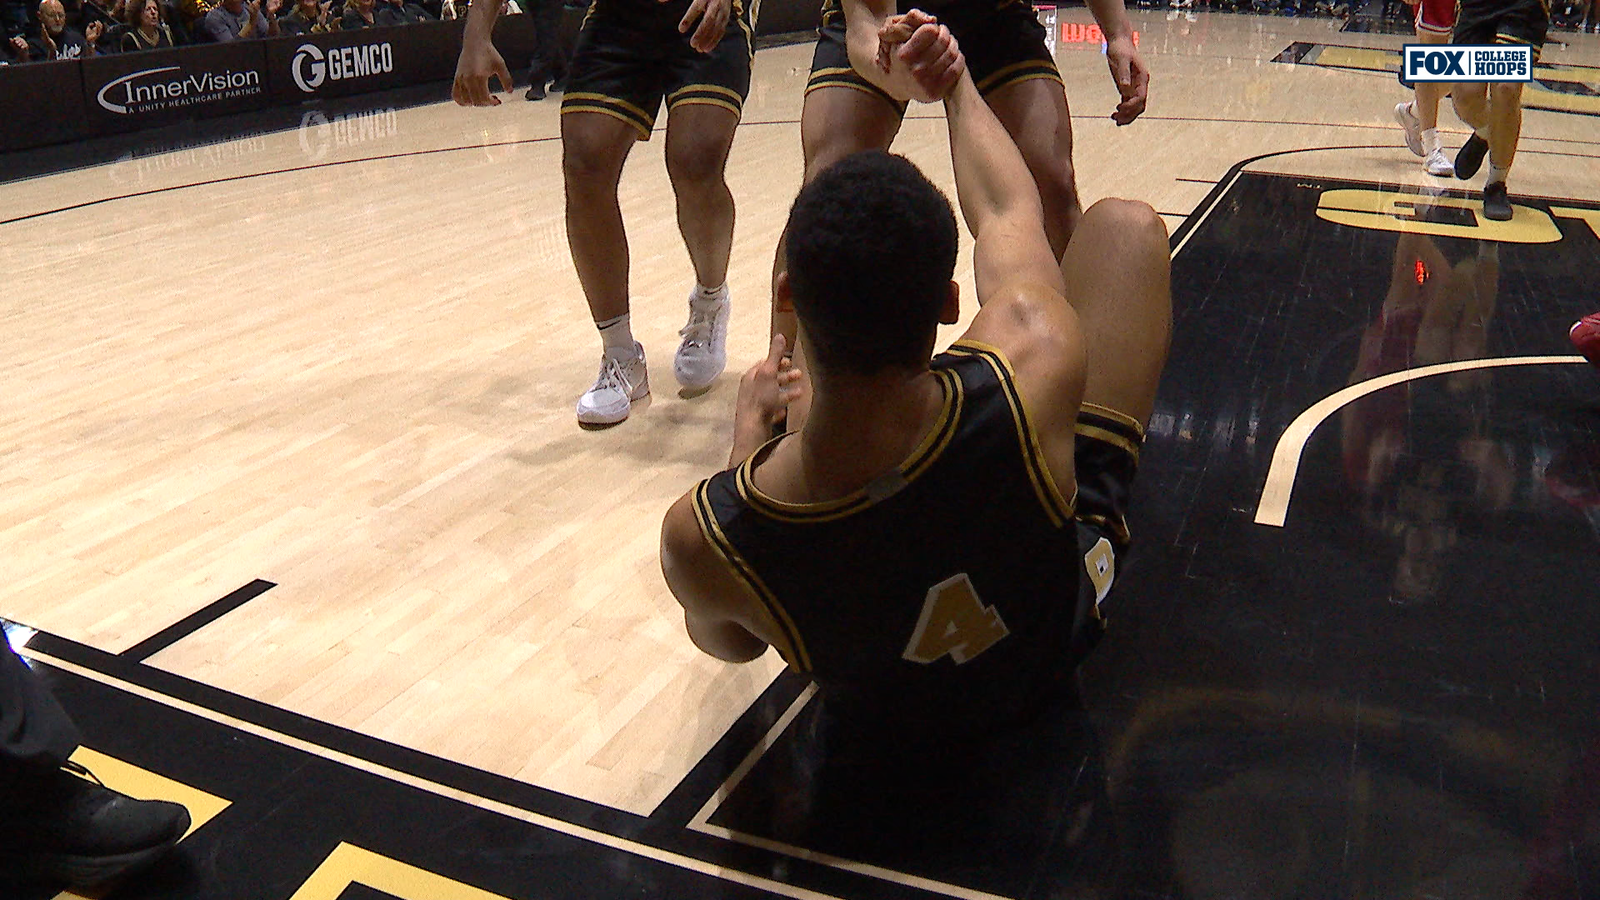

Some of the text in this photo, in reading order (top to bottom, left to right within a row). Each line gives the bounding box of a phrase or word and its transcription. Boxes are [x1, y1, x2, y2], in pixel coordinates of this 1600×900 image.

[328, 42, 393, 80] GEMCO
[124, 70, 259, 104] InnerVision
[138, 102, 166, 113] UNITY
[168, 93, 223, 107] HEALTHCARE
[225, 86, 262, 99] PARTNER
[901, 572, 1010, 666] 4
